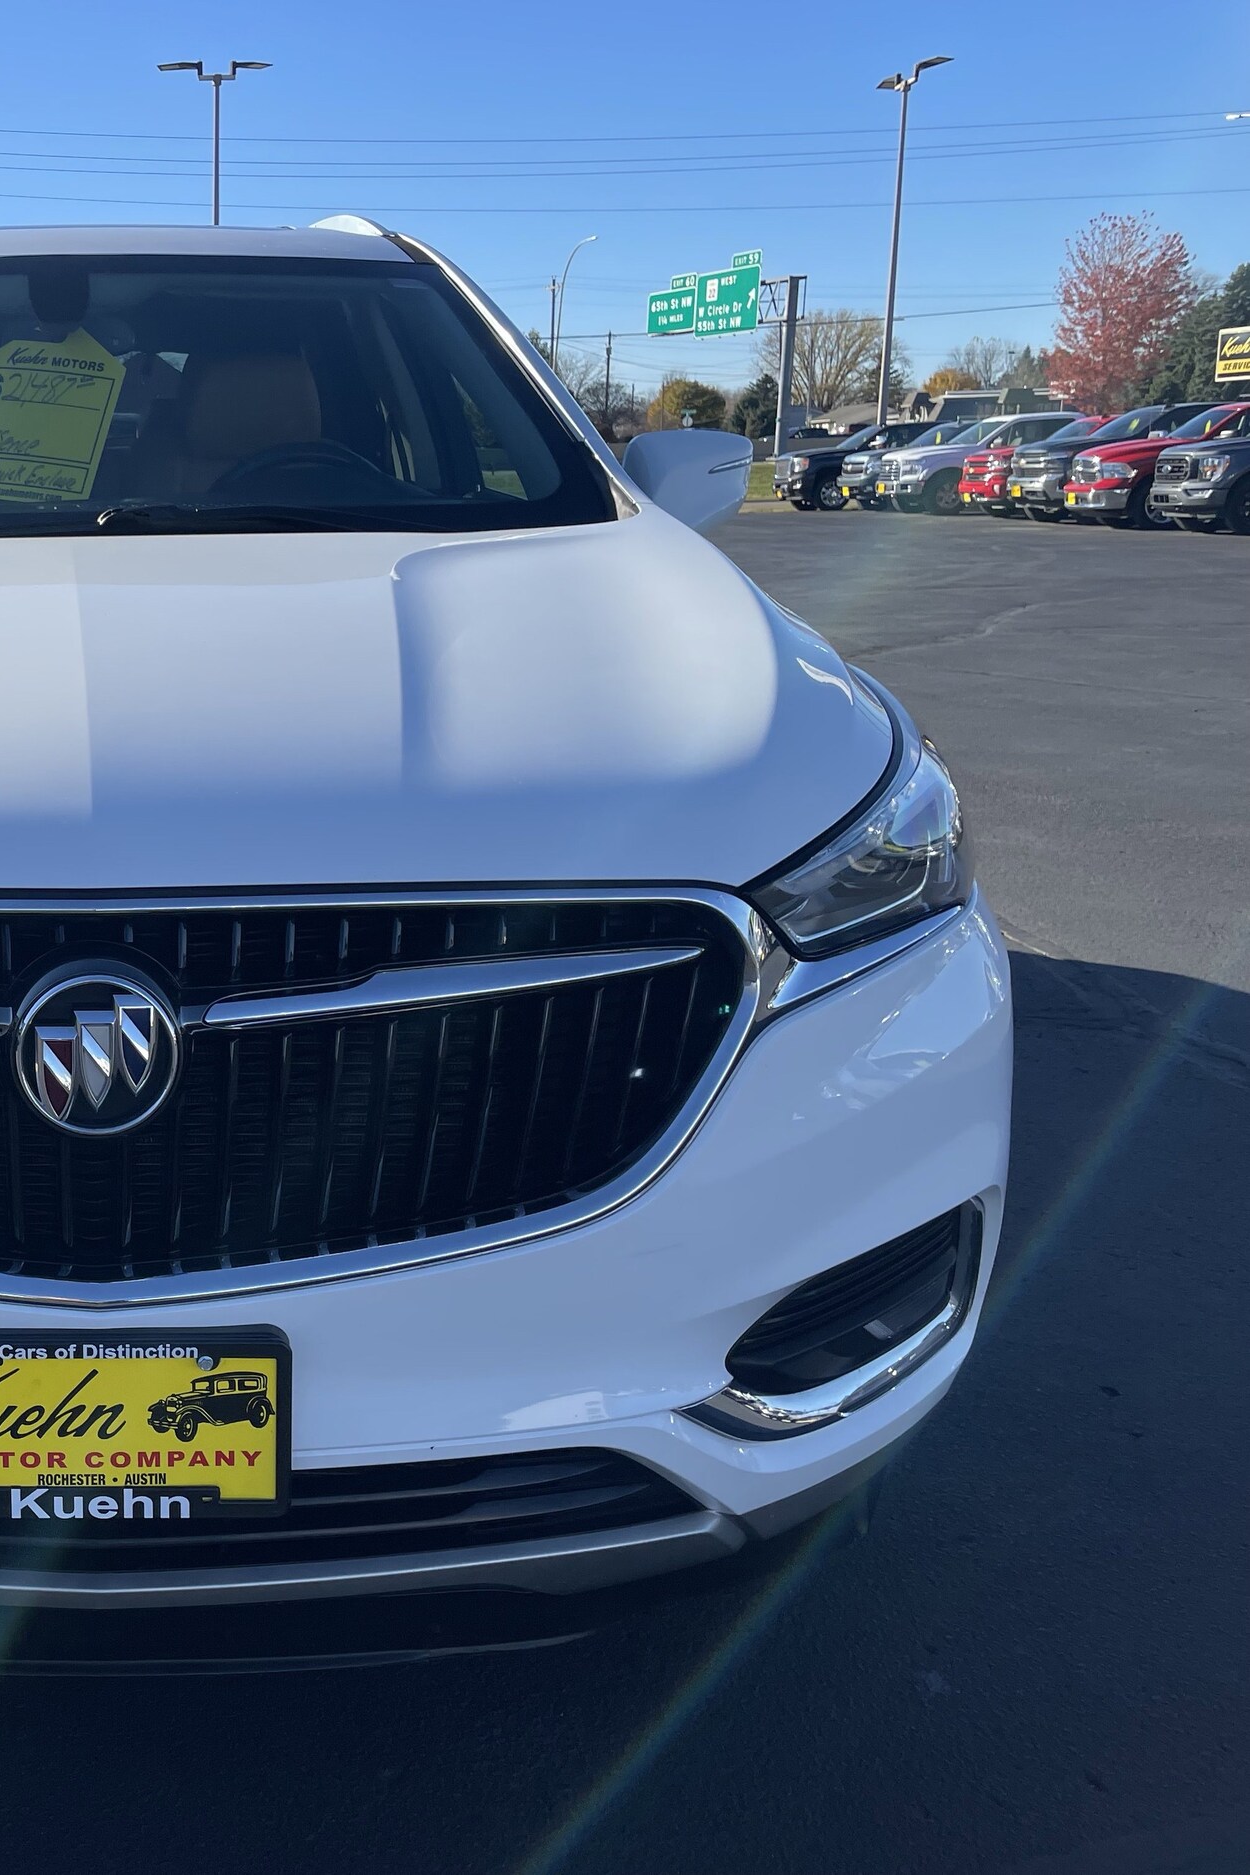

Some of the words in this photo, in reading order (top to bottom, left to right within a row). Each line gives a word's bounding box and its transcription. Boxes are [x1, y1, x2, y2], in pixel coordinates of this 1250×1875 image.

[735, 257, 747, 266] EXIT
[749, 253, 759, 264] 59
[673, 279, 684, 288] EXIT
[685, 275, 695, 287] 60
[720, 275, 737, 286] WEST
[651, 300, 668, 313] 65th
[670, 298, 679, 310] St
[681, 296, 693, 308] NW
[698, 307, 705, 318] W
[707, 304, 730, 317] Circle
[732, 301, 742, 313] Dr
[669, 313, 684, 323] MILES
[697, 320, 715, 332] 55th
[717, 318, 727, 330] St
[729, 316, 742, 328] NW
[7, 347, 49, 366] Kuehn
[51, 357, 106, 372] MOTORS
[54, 1344, 76, 1360] of
[82, 1344, 199, 1360] Distinction
[85, 1451, 262, 1467] COMPANY
[37, 1473, 106, 1486] ROCHESTER
[124, 1473, 167, 1485] AUSTIN
[10, 1488, 191, 1519] Kuehn
